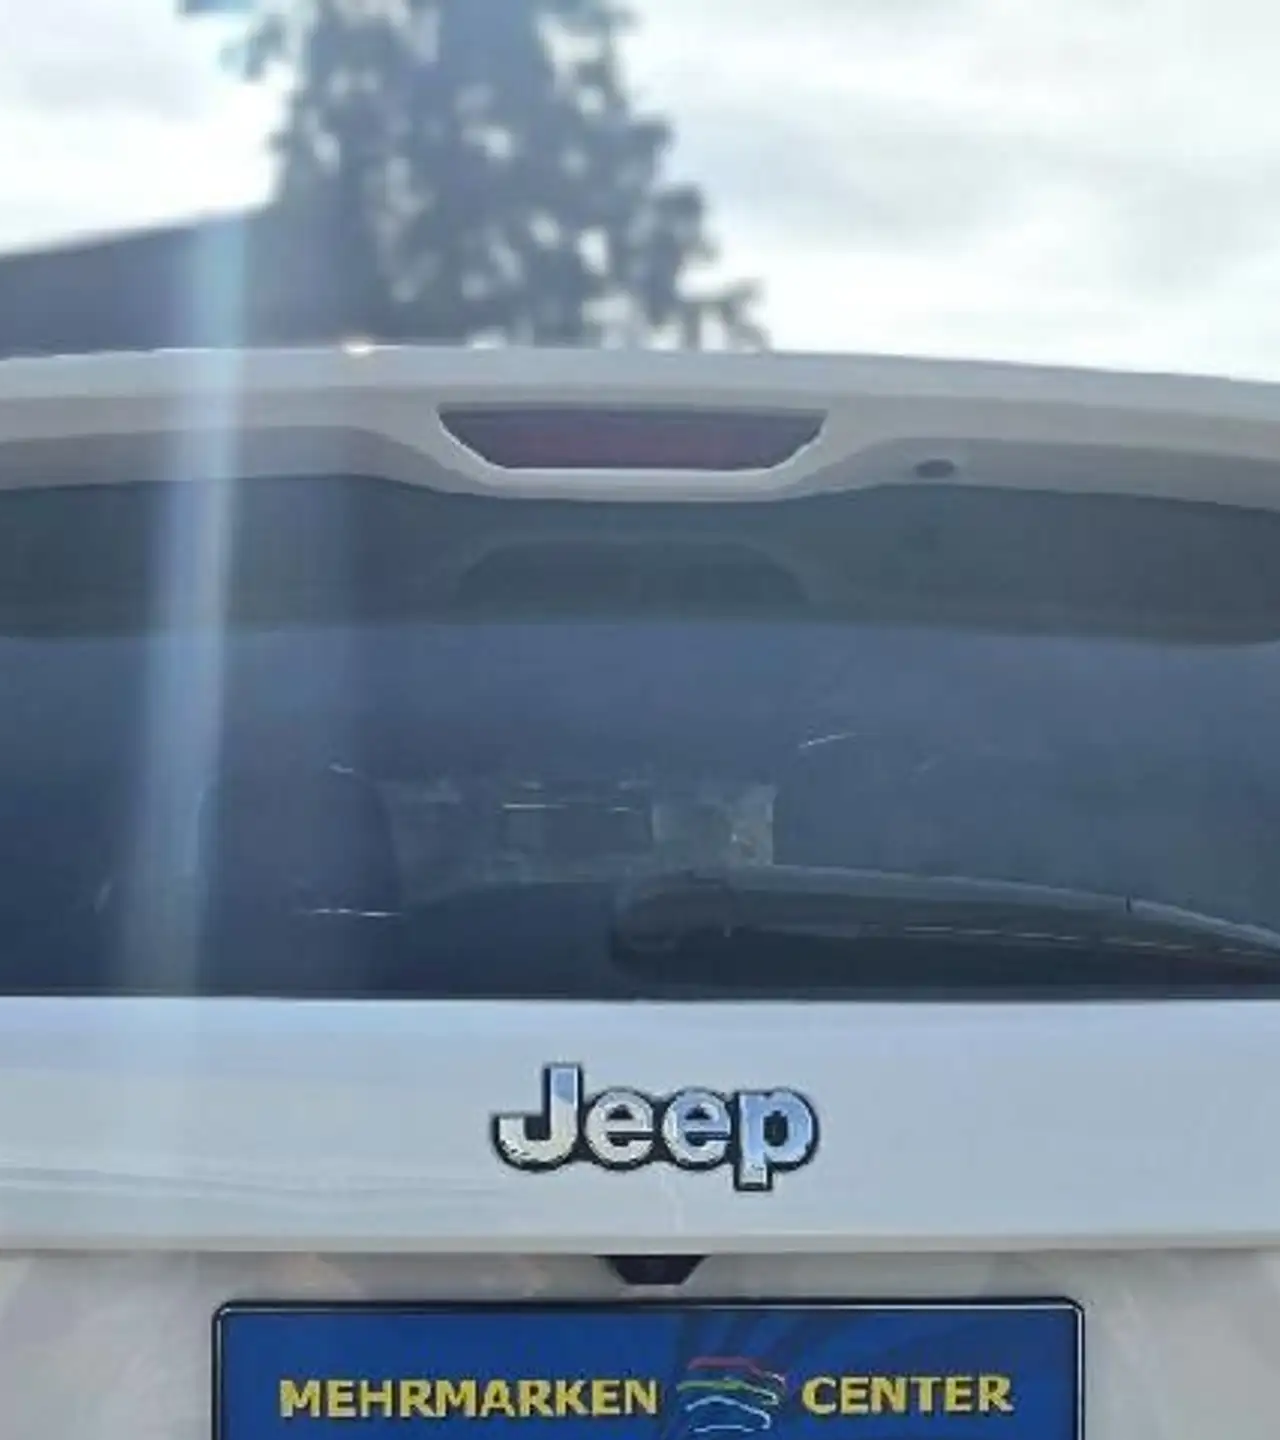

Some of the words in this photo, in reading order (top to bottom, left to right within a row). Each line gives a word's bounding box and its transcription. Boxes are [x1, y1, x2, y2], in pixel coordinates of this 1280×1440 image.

[491, 1063, 819, 1191] Jeep
[279, 1377, 657, 1417] MEHRMARKEN
[801, 1374, 1014, 1415] CENTER
